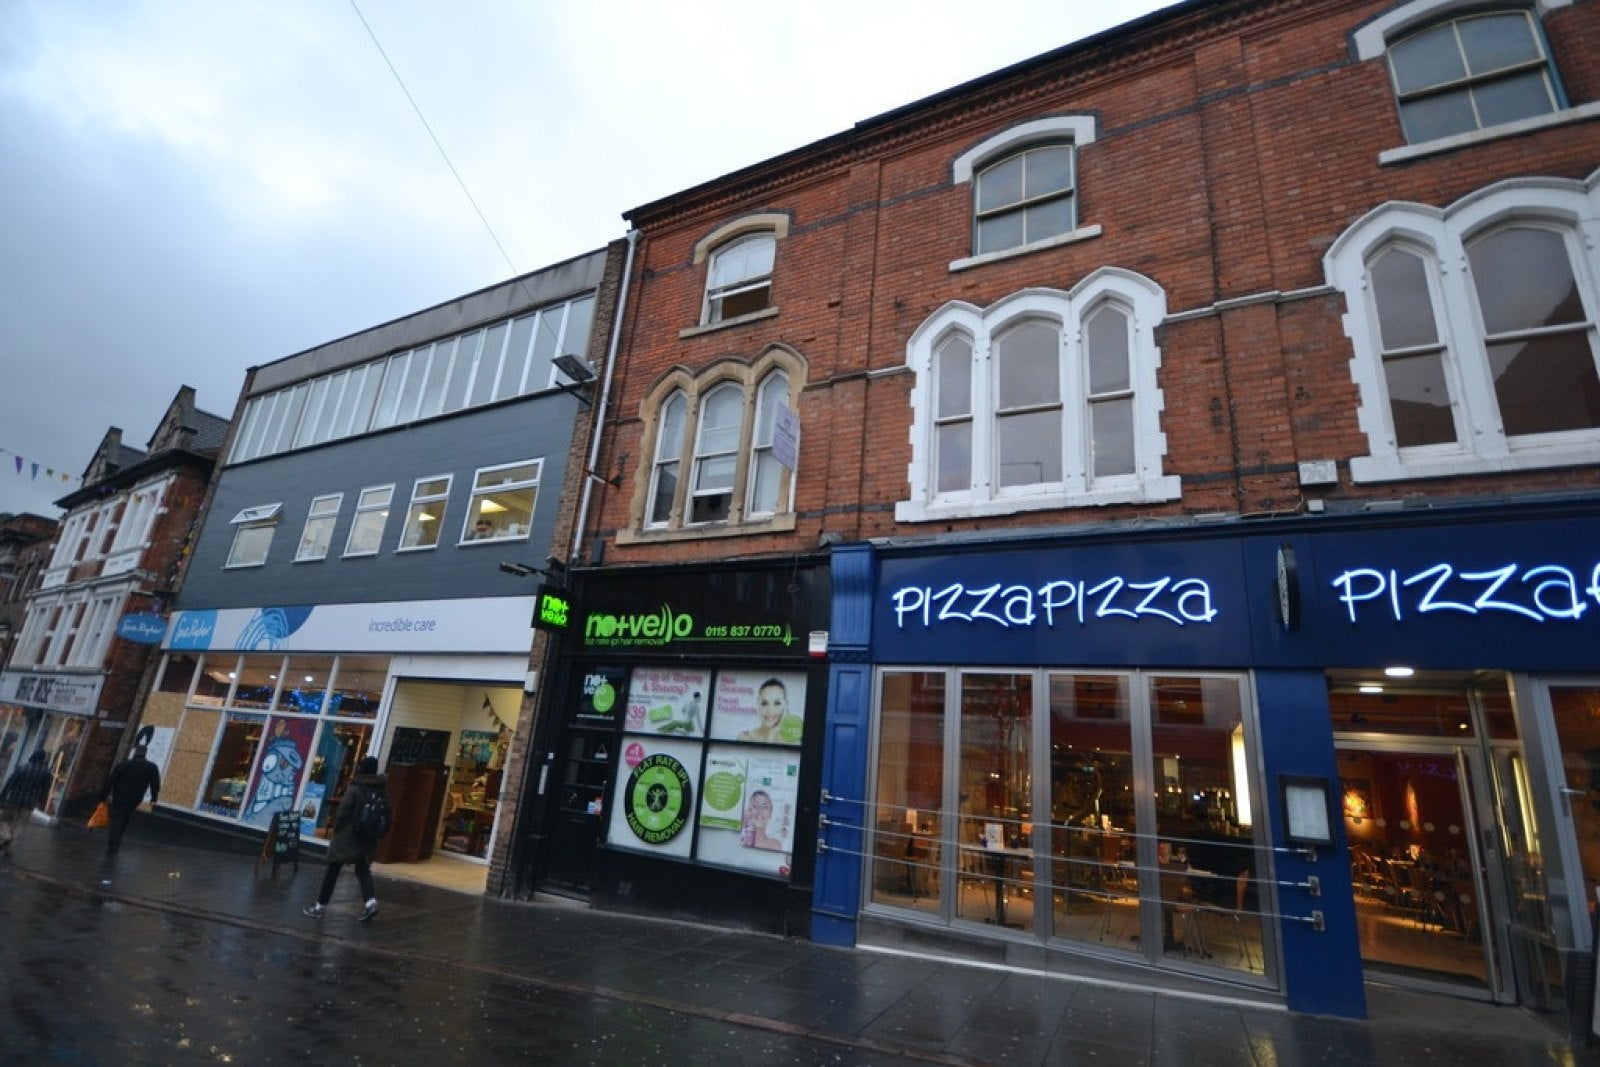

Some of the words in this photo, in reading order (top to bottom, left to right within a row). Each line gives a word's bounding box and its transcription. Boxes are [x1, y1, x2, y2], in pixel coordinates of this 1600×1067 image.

[368, 618, 413, 632] incredible
[413, 619, 437, 632] care
[705, 625, 728, 637] 0115
[730, 625, 751, 637] 837
[752, 624, 781, 637] 0770
